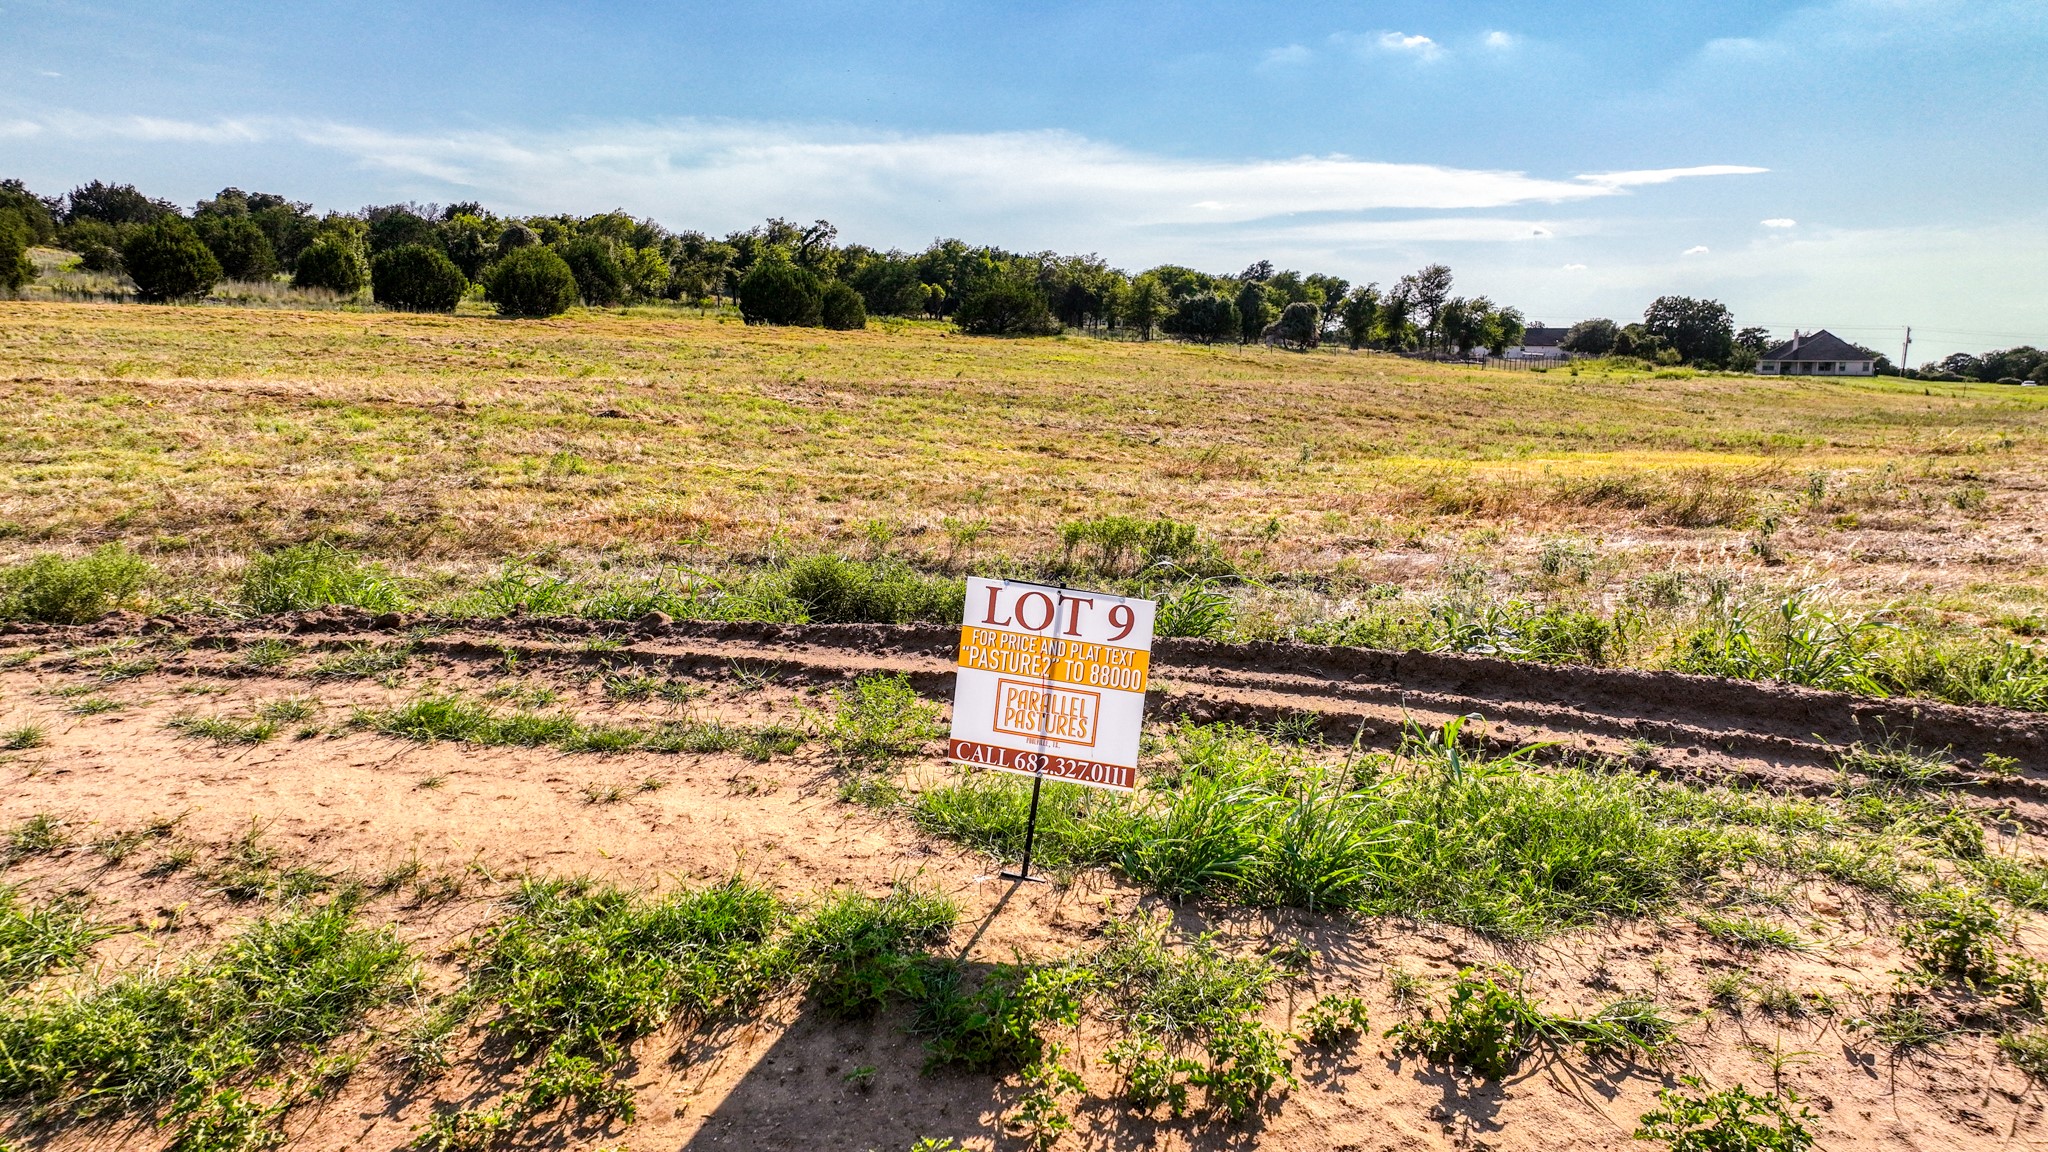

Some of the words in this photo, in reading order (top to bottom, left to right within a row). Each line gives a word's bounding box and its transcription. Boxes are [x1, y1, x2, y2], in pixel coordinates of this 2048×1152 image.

[981, 586, 1094, 637] LOT
[1107, 604, 1135, 642] 9
[972, 629, 997, 647] FOR
[1000, 633, 1036, 653] PRICE
[1040, 639, 1066, 657] AND
[1070, 643, 1102, 662] PLAT
[1105, 647, 1136, 667] TEXT
[1064, 659, 1085, 682] TO
[1090, 664, 1142, 691] 88000
[1006, 687, 1088, 719] PARALLEL
[1003, 707, 1088, 739] PASTURES
[956, 742, 1010, 768] CALL
[1014, 752, 1128, 787] 682.327.0111
